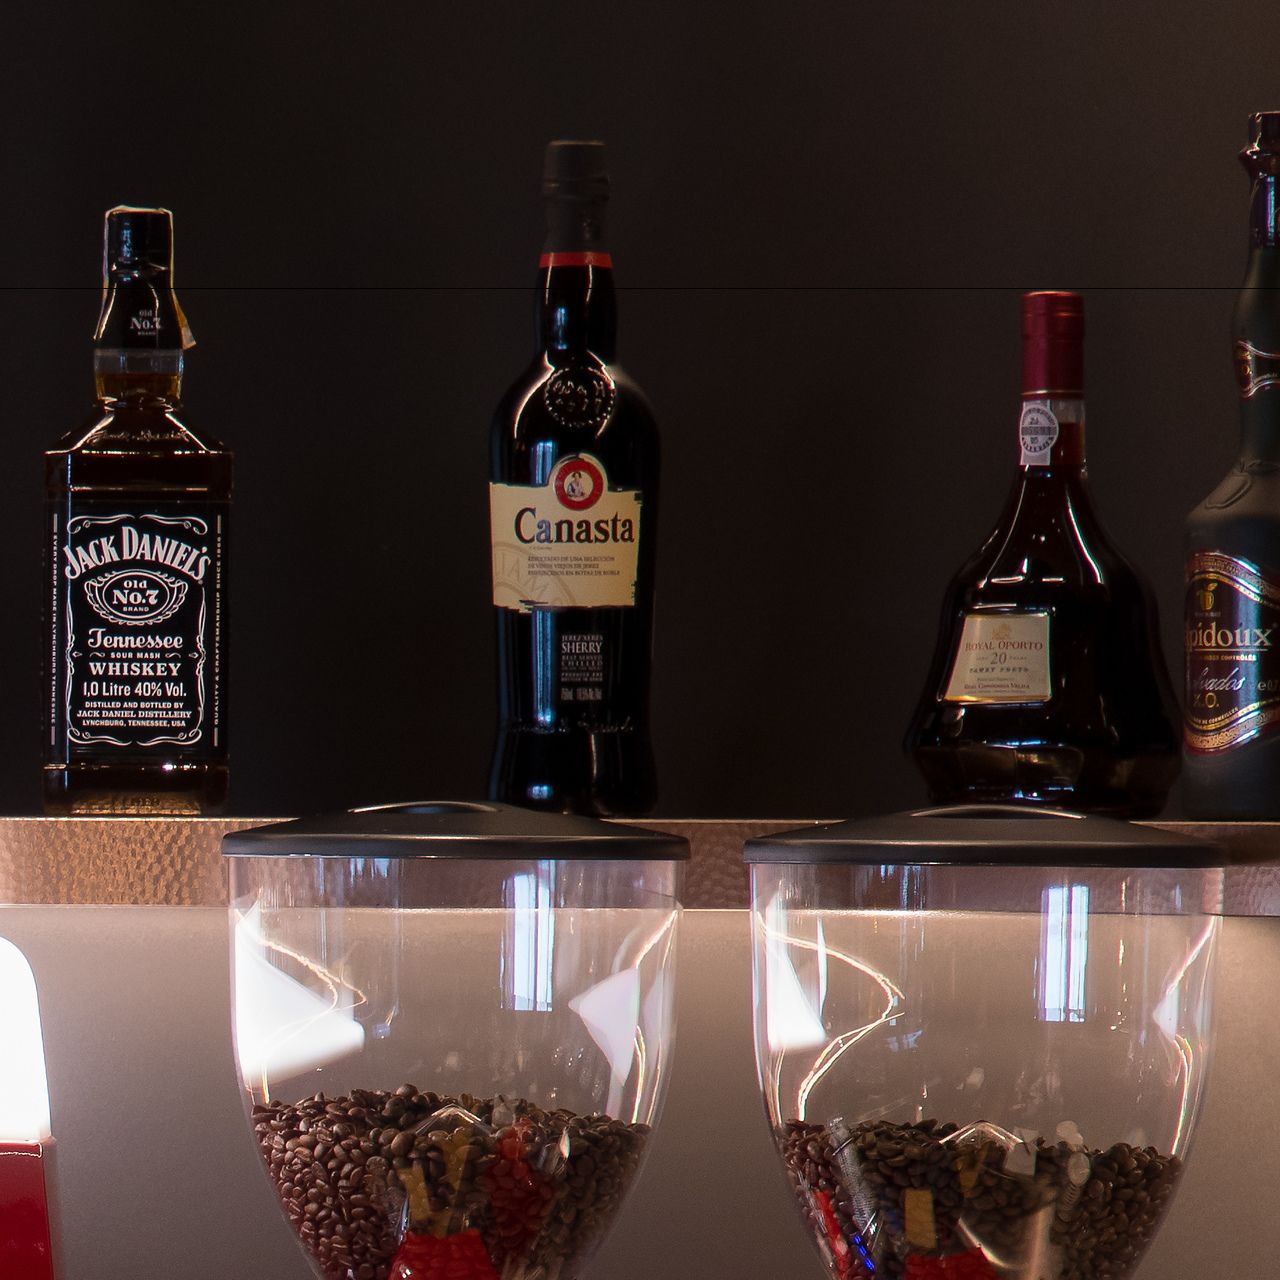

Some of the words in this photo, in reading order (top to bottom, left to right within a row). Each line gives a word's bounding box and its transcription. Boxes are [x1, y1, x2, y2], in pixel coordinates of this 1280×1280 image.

[514, 506, 635, 544] Canasta
[63, 535, 121, 580] JACK
[123, 579, 148, 589] Old
[112, 589, 160, 605] No.7
[87, 628, 184, 649] Tennessee
[561, 641, 603, 654] SHERRY
[965, 641, 995, 652] ROYAL
[998, 640, 1043, 651] OPORTO
[990, 651, 1007, 665] 20
[88, 662, 182, 677] WHISKEY
[102, 681, 131, 697] Litre
[134, 681, 162, 697] 40%
[165, 681, 187, 697] Vol.
[85, 701, 121, 709] DISTILLED
[123, 701, 138, 709] AND
[139, 701, 172, 709] BOTTLED
[173, 701, 184, 709] BY
[76, 710, 101, 718] JACK
[102, 710, 137, 718] DANIEL
[138, 710, 192, 719] DISTILLERY
[171, 720, 186, 728] USA
